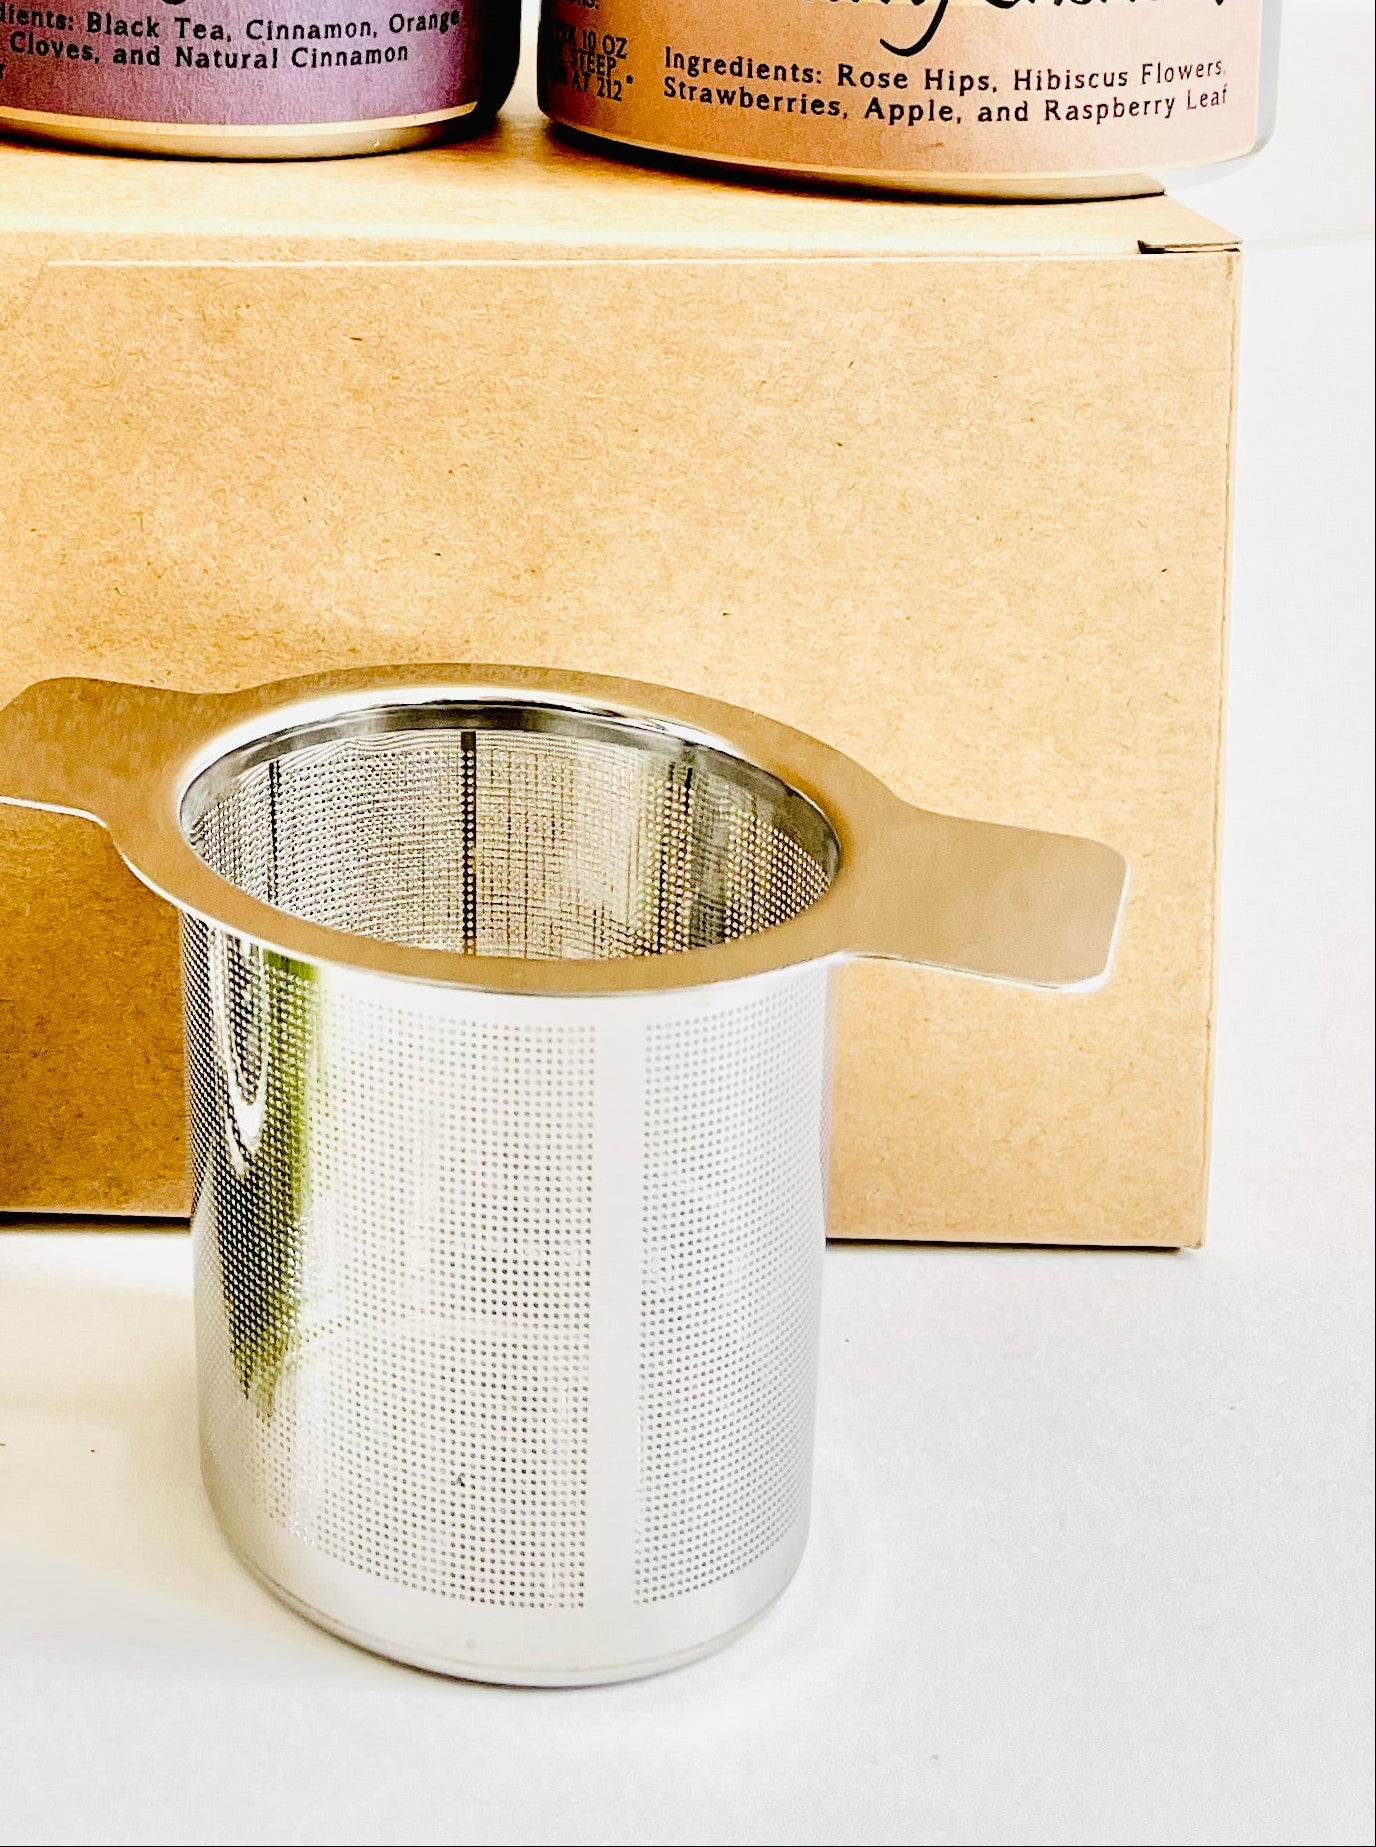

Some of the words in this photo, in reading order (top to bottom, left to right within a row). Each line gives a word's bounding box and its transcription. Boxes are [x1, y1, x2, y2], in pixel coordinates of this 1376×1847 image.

[87, 11, 160, 38] Black
[175, 17, 232, 43] Tea,
[246, 19, 378, 41] Cinnamon,
[389, 9, 460, 34] Orange
[582, 28, 597, 52] 10
[602, 34, 627, 60] OZ
[9, 30, 100, 64] Cloves,
[113, 45, 161, 66] and
[175, 46, 278, 69] Natural
[291, 45, 409, 68] Cinnamon
[570, 47, 617, 79] STEEP
[664, 46, 822, 84] Ingredients:
[837, 63, 909, 90] Rose
[925, 68, 998, 96] Hips,
[1014, 68, 1129, 91] Hibiscus
[664, 76, 848, 119] Strawberries,
[864, 96, 962, 126] Apple,
[977, 100, 1029, 122] and
[1044, 95, 1176, 125] Raspberry
[1186, 83, 1228, 110] Leaf
